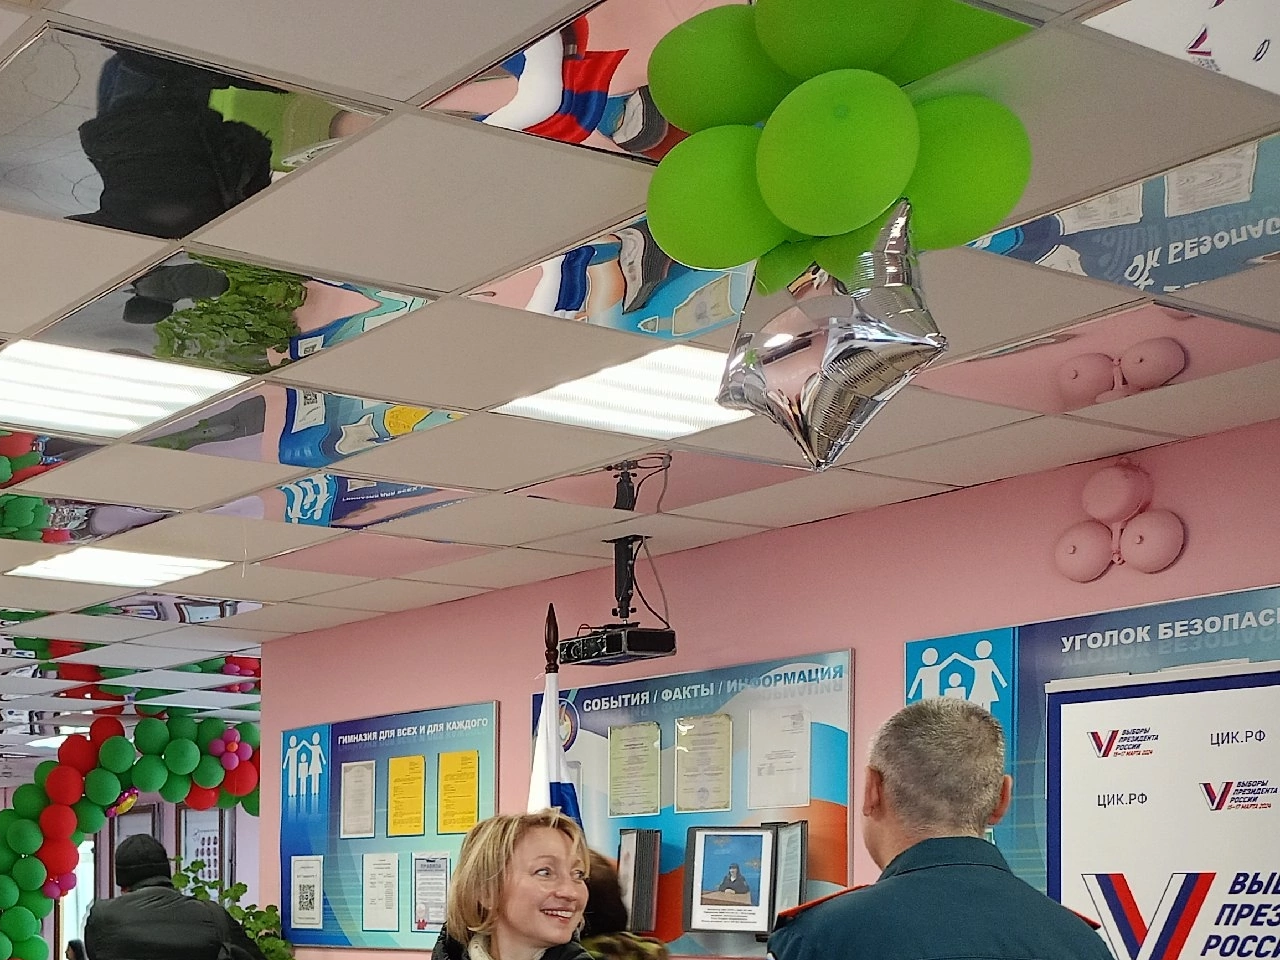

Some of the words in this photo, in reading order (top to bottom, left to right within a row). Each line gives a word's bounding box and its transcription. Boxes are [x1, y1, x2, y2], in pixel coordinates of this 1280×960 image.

[1061, 625, 1151, 653] УГОЛОК
[1158, 607, 1280, 641] БЕЗОПАС
[583, 691, 650, 712] СОБЫТИЯ
[661, 682, 715, 702] ФАКТЫ
[726, 664, 844, 692] ИНФОРМАЦИЯ
[338, 731, 377, 745] ГИМНАЗИЯ
[379, 729, 395, 741] ДЛЯ
[397, 726, 418, 737] ВСЕХ
[419, 725, 426, 734] И
[427, 723, 444, 735] ДЛЯ
[446, 718, 489, 732] КАЖДОГО
[1210, 729, 1266, 747] ЦИК.РФ
[1097, 792, 1147, 808] ЦИК.РФ
